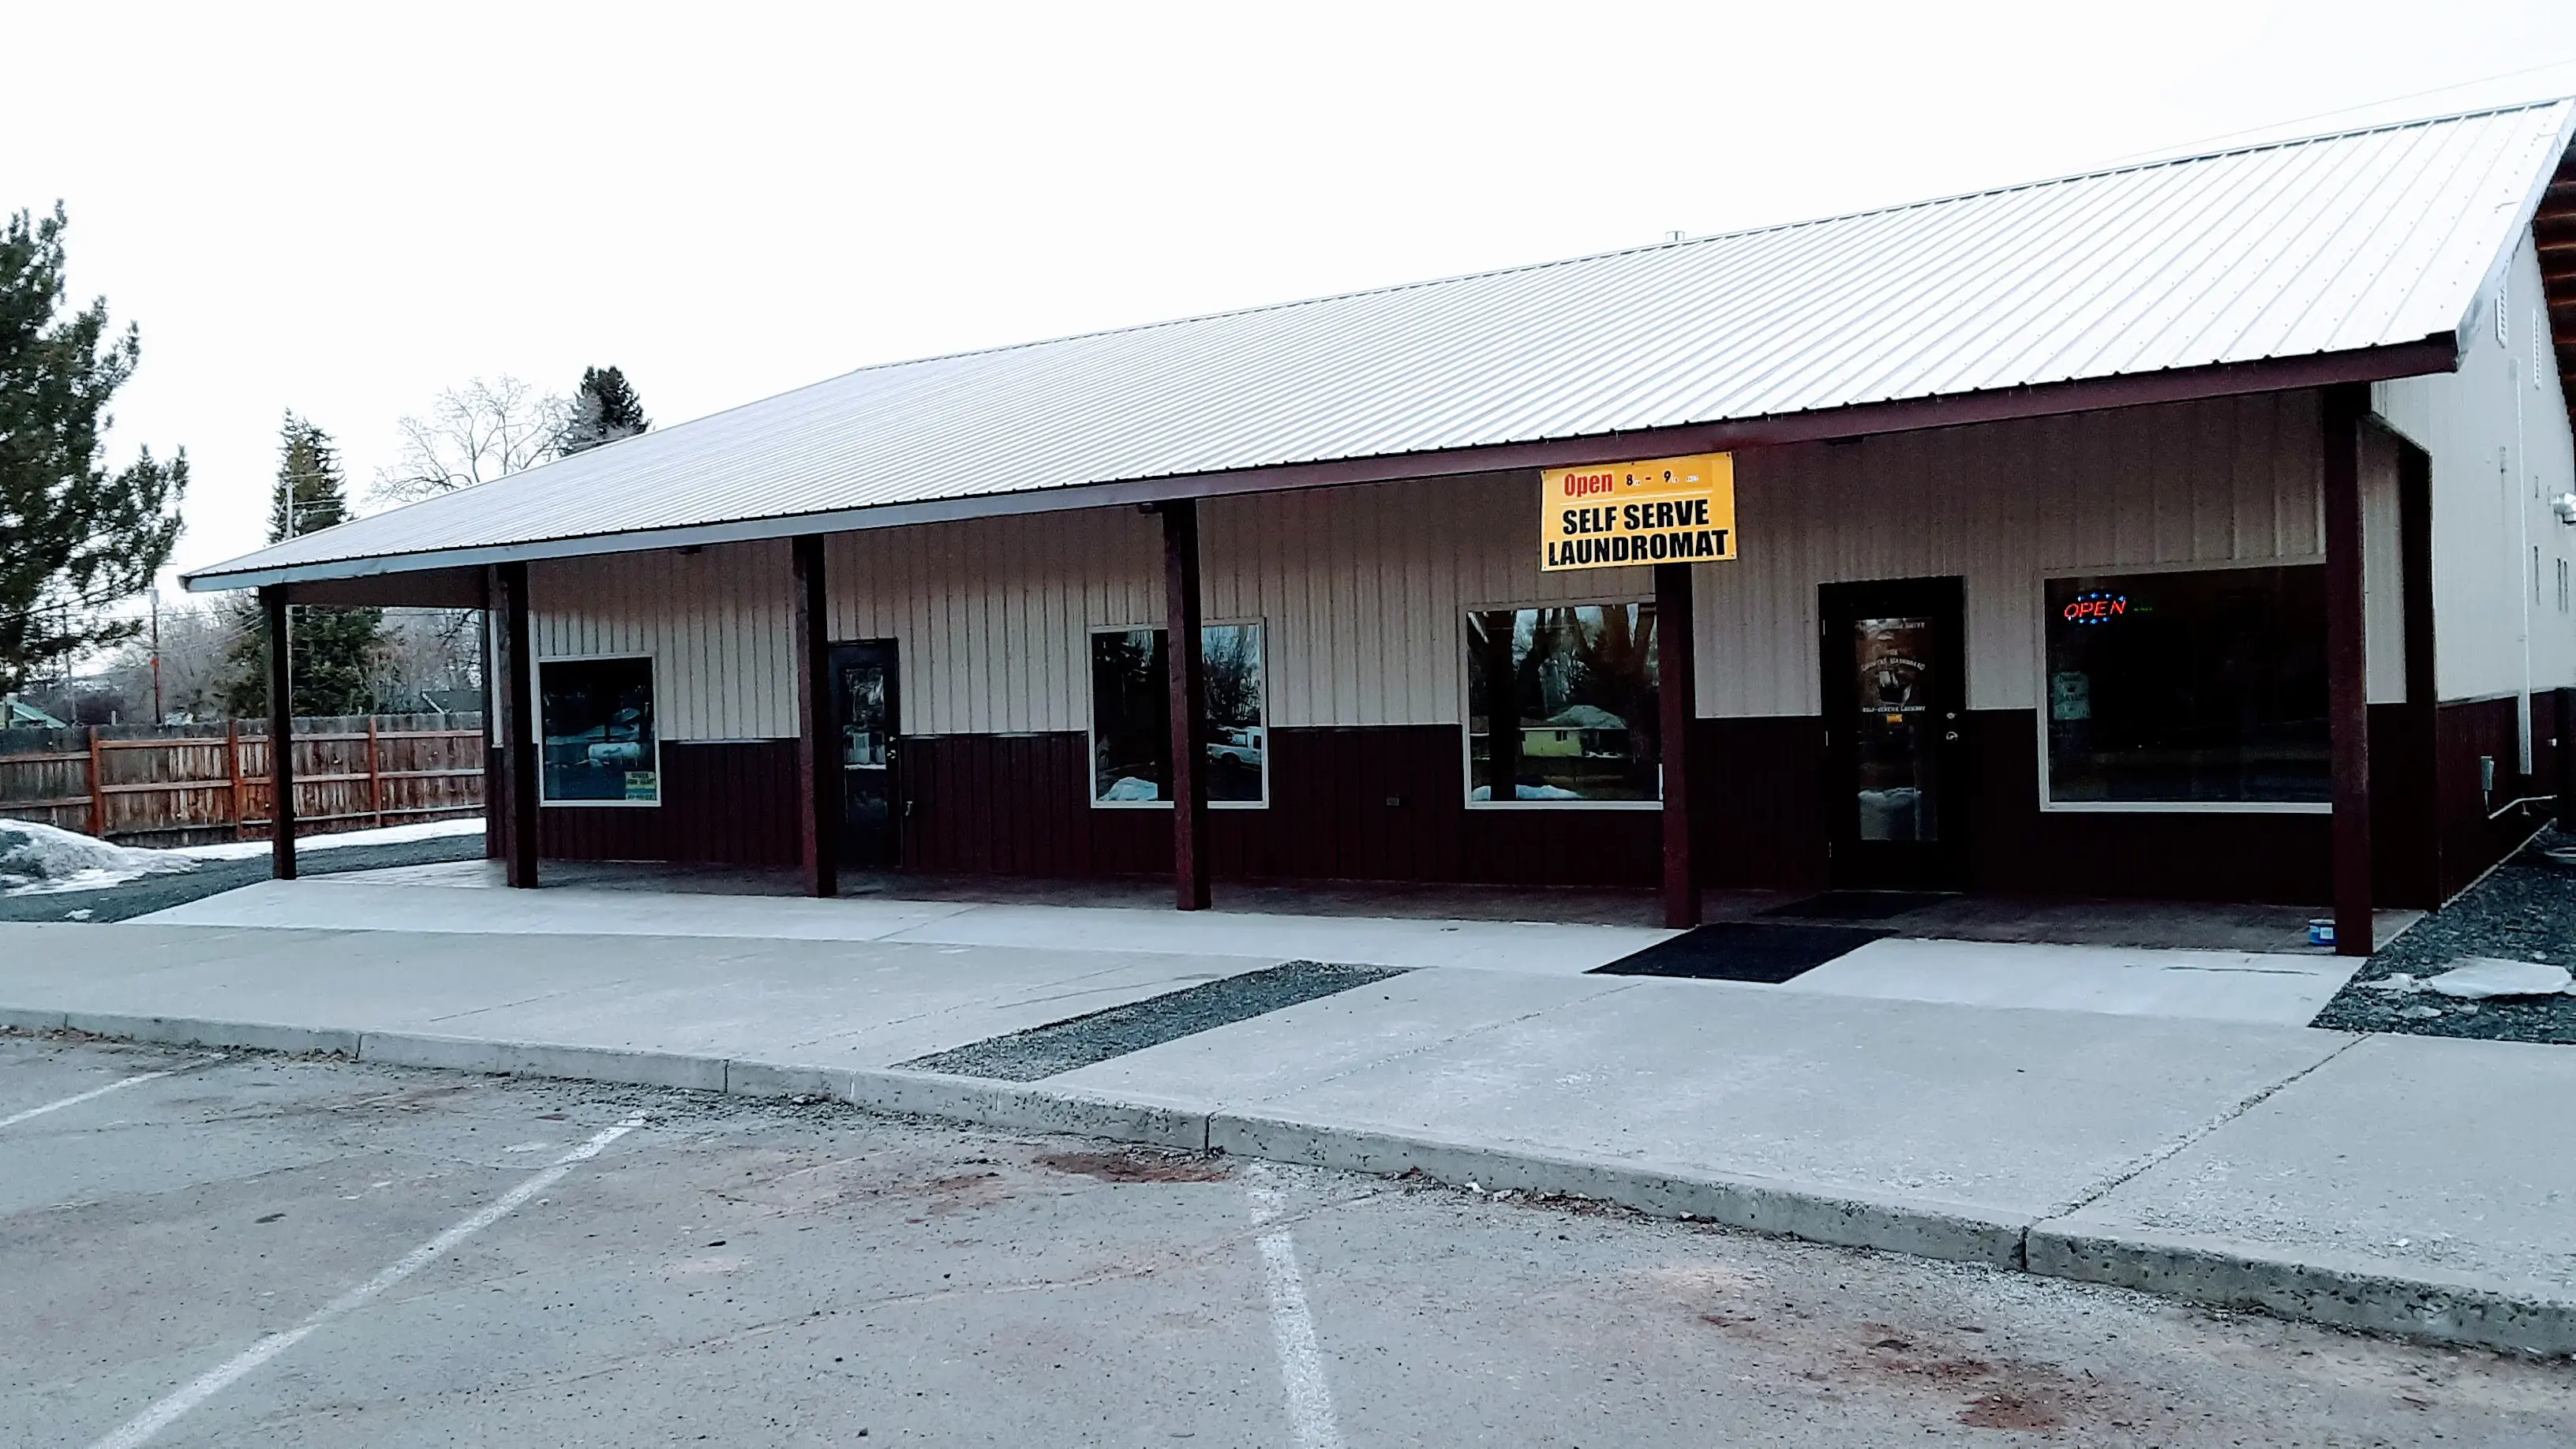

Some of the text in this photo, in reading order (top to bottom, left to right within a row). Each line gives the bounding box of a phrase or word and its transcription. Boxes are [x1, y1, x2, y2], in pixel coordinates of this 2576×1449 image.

[1564, 473, 1613, 497] Open
[1626, 474, 1634, 486] 8
[1664, 470, 1672, 483] 9
[1563, 499, 1709, 535] SELF SERVE
[1548, 529, 1729, 567] LAUNDROMAT
[2063, 600, 2127, 618] OPEN
